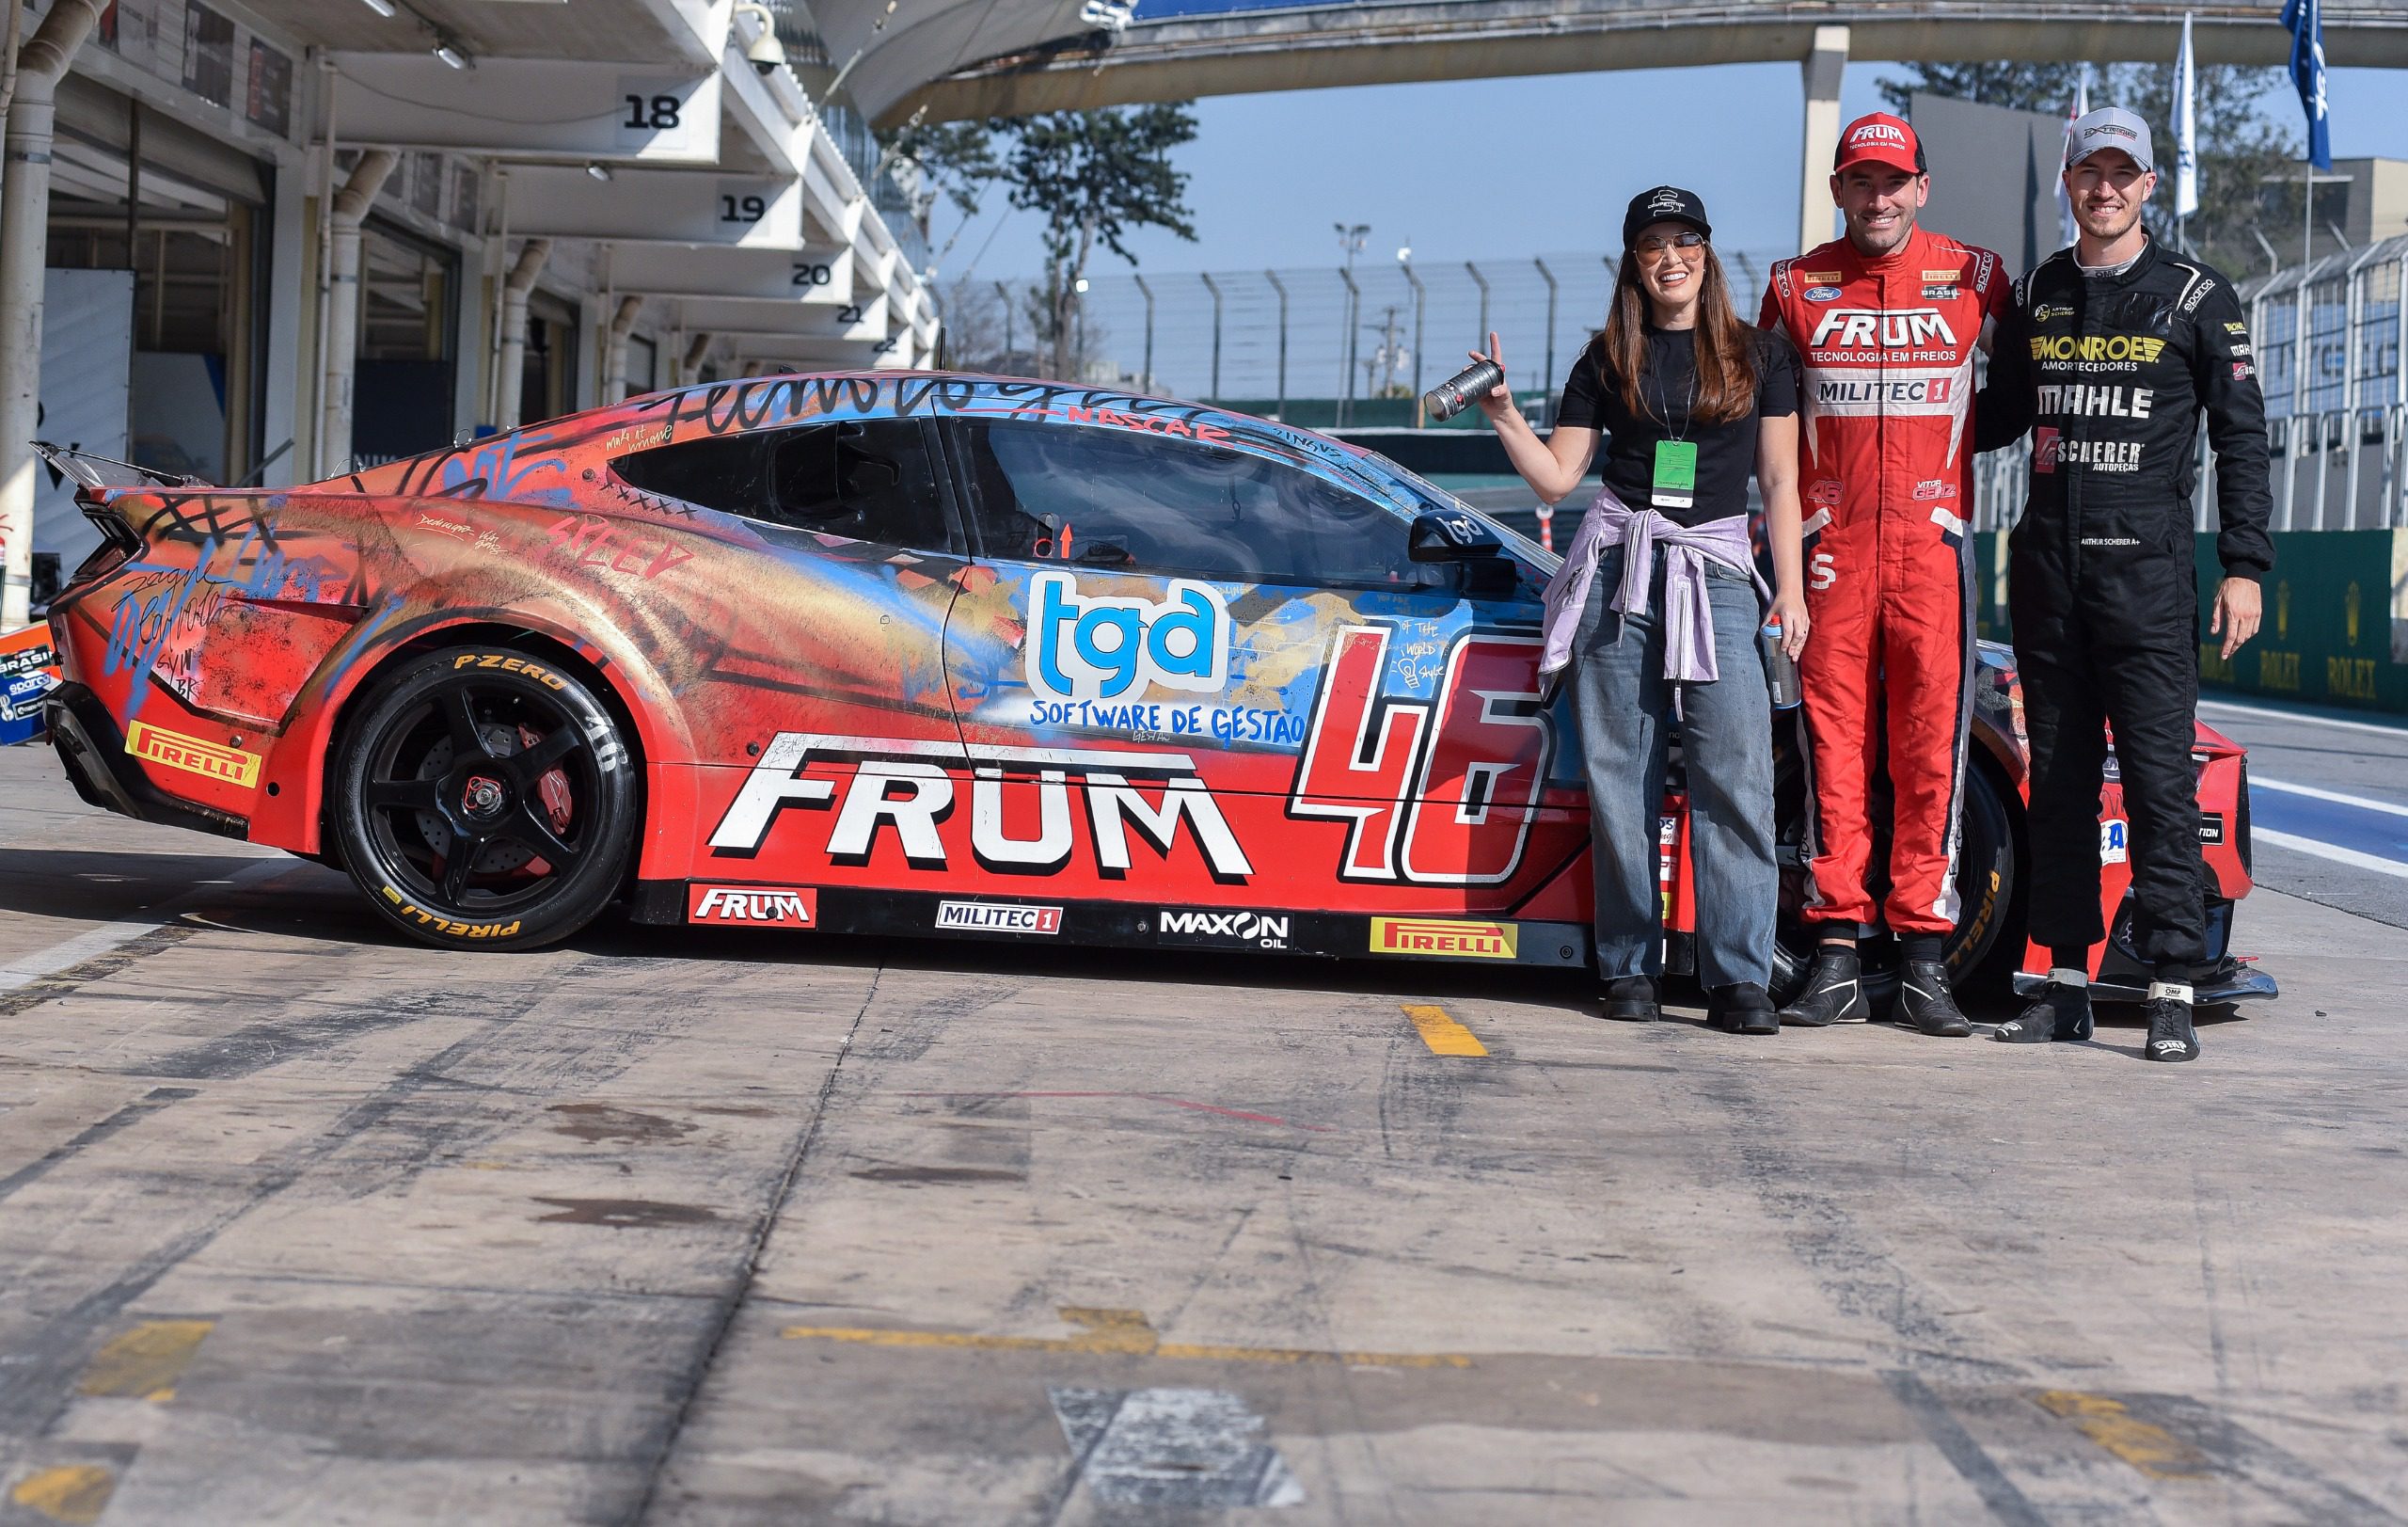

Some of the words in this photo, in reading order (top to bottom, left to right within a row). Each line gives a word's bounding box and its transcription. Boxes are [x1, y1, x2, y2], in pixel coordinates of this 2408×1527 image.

[625, 94, 680, 129] 18
[1849, 124, 1906, 143] FRUM
[721, 195, 765, 222] 19
[792, 263, 831, 285] 20
[1807, 273, 1839, 281] PIRELLI
[1925, 271, 1959, 280] PIRELLI
[1976, 252, 1993, 294] sparco
[2096, 270, 2118, 278] OMP
[1811, 288, 1834, 299] Ford
[2184, 278, 2215, 314] sparco
[836, 305, 863, 324] 21
[1811, 308, 1957, 348] FRUM
[872, 338, 897, 353] 22
[1811, 351, 1888, 362] TECNOLOGIA
[1892, 352, 1909, 362] EM
[1913, 350, 1956, 361] FREIOS
[2037, 336, 2147, 361] MONROE
[2041, 361, 2138, 373] AMORTECEDORES
[1820, 382, 1925, 402] MILITEC
[2037, 385, 2154, 419] MAHLE
[1068, 406, 1235, 449] NASCAR
[2057, 440, 2142, 464] SCHERER
[2093, 462, 2139, 473] AUTOPEÇAS
[1808, 480, 1844, 505] 46
[1912, 484, 1956, 501] GENZ
[1917, 479, 1942, 489] VITOR
[2131, 537, 2141, 546] A+
[8, 673, 50, 695] sparco
[2326, 656, 2377, 700] ROLEX
[1030, 700, 1162, 732] SOFTWARE
[1171, 709, 1203, 735] DE
[1211, 708, 1306, 751] GESTÃO
[137, 727, 248, 781] PIRELLI
[1291, 625, 1552, 883] 46
[708, 731, 1255, 885] FRUM
[2198, 828, 2219, 838] TION
[695, 888, 810, 922] FRUM
[402, 904, 522, 938] PIRELLI
[943, 906, 1037, 928] MILITEC
[1160, 911, 1289, 940] MAXON
[1951, 870, 2001, 966] PIRELL
[1259, 938, 1288, 949] OIL
[1384, 921, 1504, 954] PIRELLI
[2152, 1040, 2188, 1050] OMP
